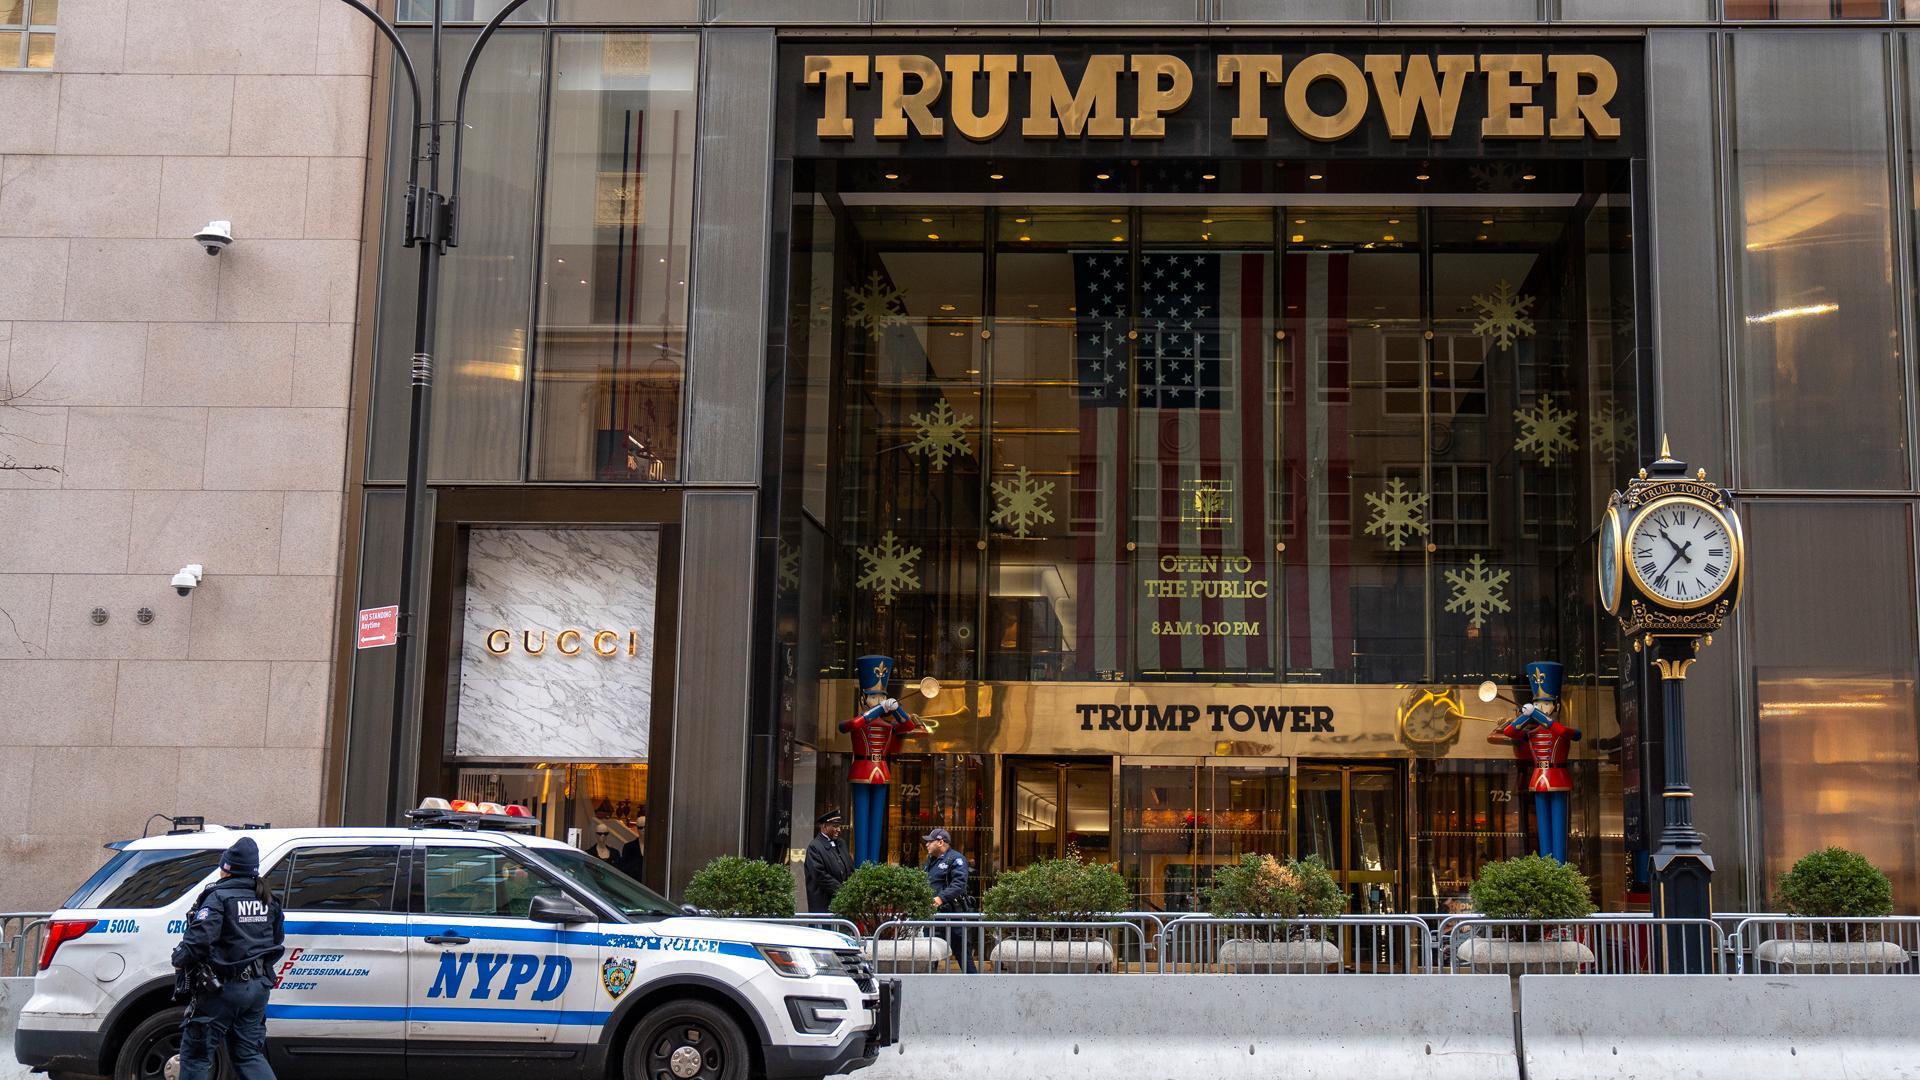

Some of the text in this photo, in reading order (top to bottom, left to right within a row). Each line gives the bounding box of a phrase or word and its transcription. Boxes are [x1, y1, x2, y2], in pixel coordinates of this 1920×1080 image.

[804, 52, 1621, 142] TRUMP TOWER
[1641, 483, 1714, 501] TRUMP TOWER
[1160, 555, 1252, 574] OPEN TO
[1144, 580, 1269, 599] THE PUBLIC
[361, 610, 392, 621] NO STANDING
[1195, 623, 1211, 636] to
[486, 629, 637, 657] GUCCI
[1076, 704, 1335, 733] TRUMP TOWER
[901, 784, 921, 796] 725
[1490, 790, 1512, 801] 725
[237, 900, 269, 916] NYPD
[290, 948, 344, 961] COURTESY
[278, 962, 370, 976] PROFESSIONALISM
[427, 951, 573, 1002] NYPD
